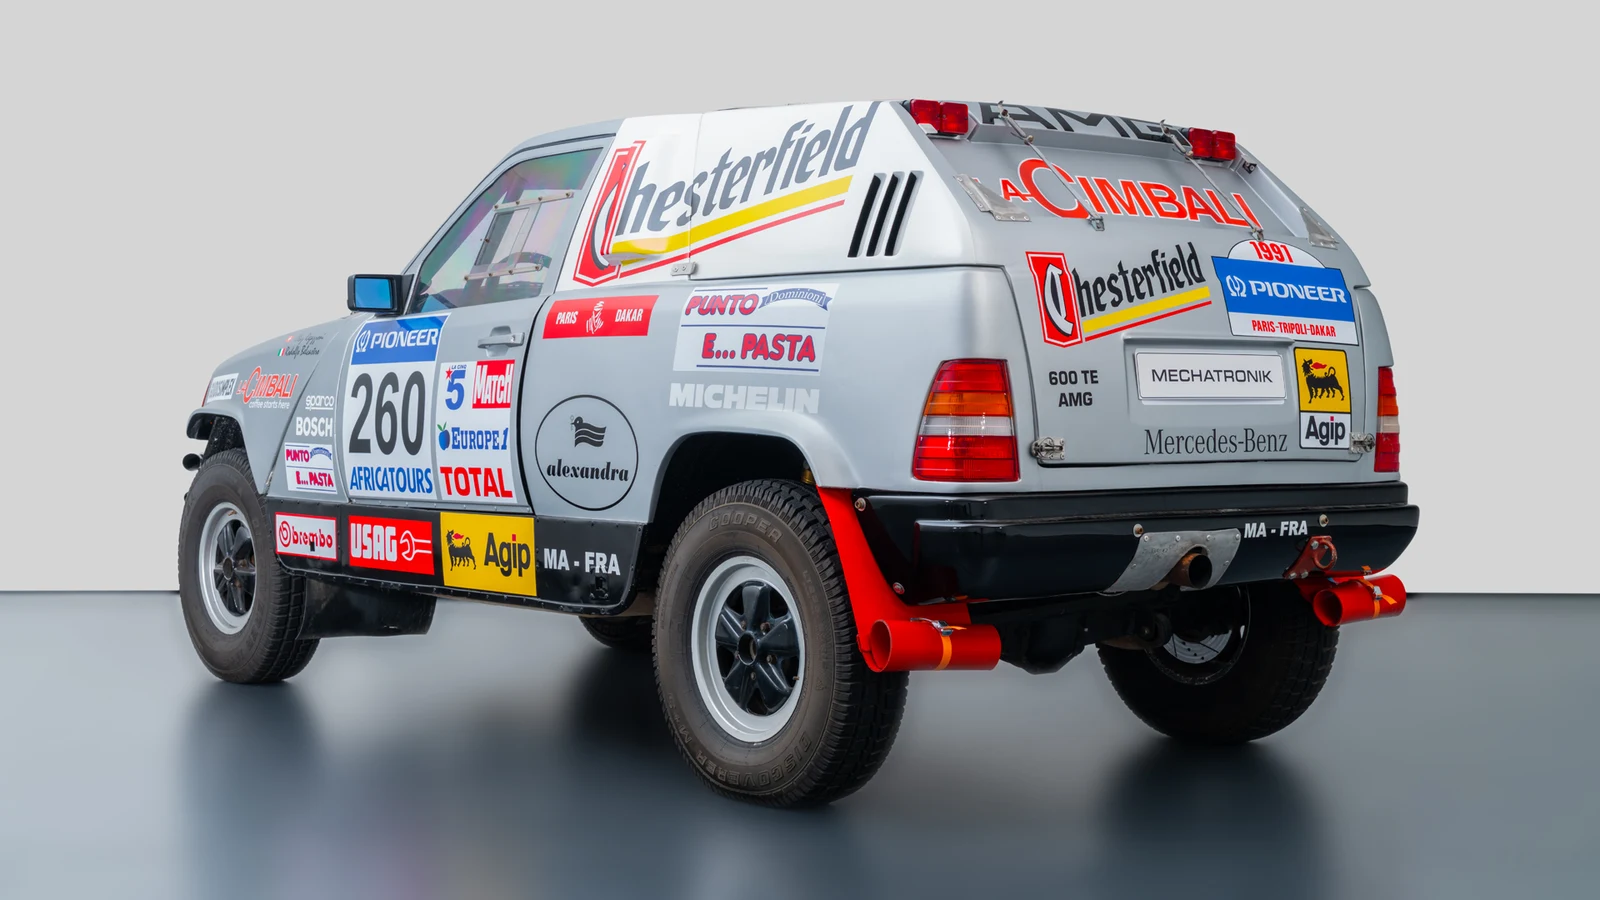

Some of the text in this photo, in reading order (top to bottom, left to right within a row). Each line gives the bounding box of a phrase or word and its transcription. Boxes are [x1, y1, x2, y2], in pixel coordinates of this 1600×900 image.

[978, 101, 1191, 148] AMG
[591, 100, 880, 271] Chesterfield
[1018, 158, 1262, 229] CIMBALI
[1249, 240, 1294, 263] 1991
[685, 289, 824, 316] PUNTO Dominioni
[1043, 242, 1206, 337] Chesterfield
[1248, 280, 1347, 303] PIONEER
[555, 308, 644, 325] PARIS DAKAR
[1252, 319, 1336, 338] PARIS-TRIPOLI-DAKAR
[370, 328, 439, 349] PIONEER
[741, 333, 816, 362] PASTA
[236, 379, 246, 394] LA
[243, 366, 299, 404] CIMBALI
[473, 363, 514, 405] MATCH
[1049, 370, 1099, 386] 600 TE
[1151, 368, 1273, 384] MECHATRONIK
[305, 394, 334, 411] sparco
[445, 370, 466, 410] 5
[669, 382, 820, 414] MICHELIN
[1058, 391, 1093, 408] AMG
[278, 400, 290, 409] here
[349, 371, 426, 456] 260
[295, 416, 333, 438] BOSCH
[451, 427, 509, 450] EUROPE 1
[1305, 415, 1346, 446] Agip
[1144, 427, 1288, 455] Mercedes-Benz
[285, 448, 310, 463] PUNTO
[308, 471, 334, 487] PASTA
[350, 466, 433, 494] AFRICATOURS
[440, 466, 513, 498] TOTAL
[546, 458, 629, 482] alexandra
[291, 522, 333, 549] brembo
[708, 511, 784, 544] COOPER
[1243, 522, 1267, 538] MA
[1279, 520, 1309, 537] FRA
[350, 523, 398, 562] USAG
[484, 532, 531, 577] Agip
[543, 548, 570, 571] MA
[585, 552, 621, 576] FRA
